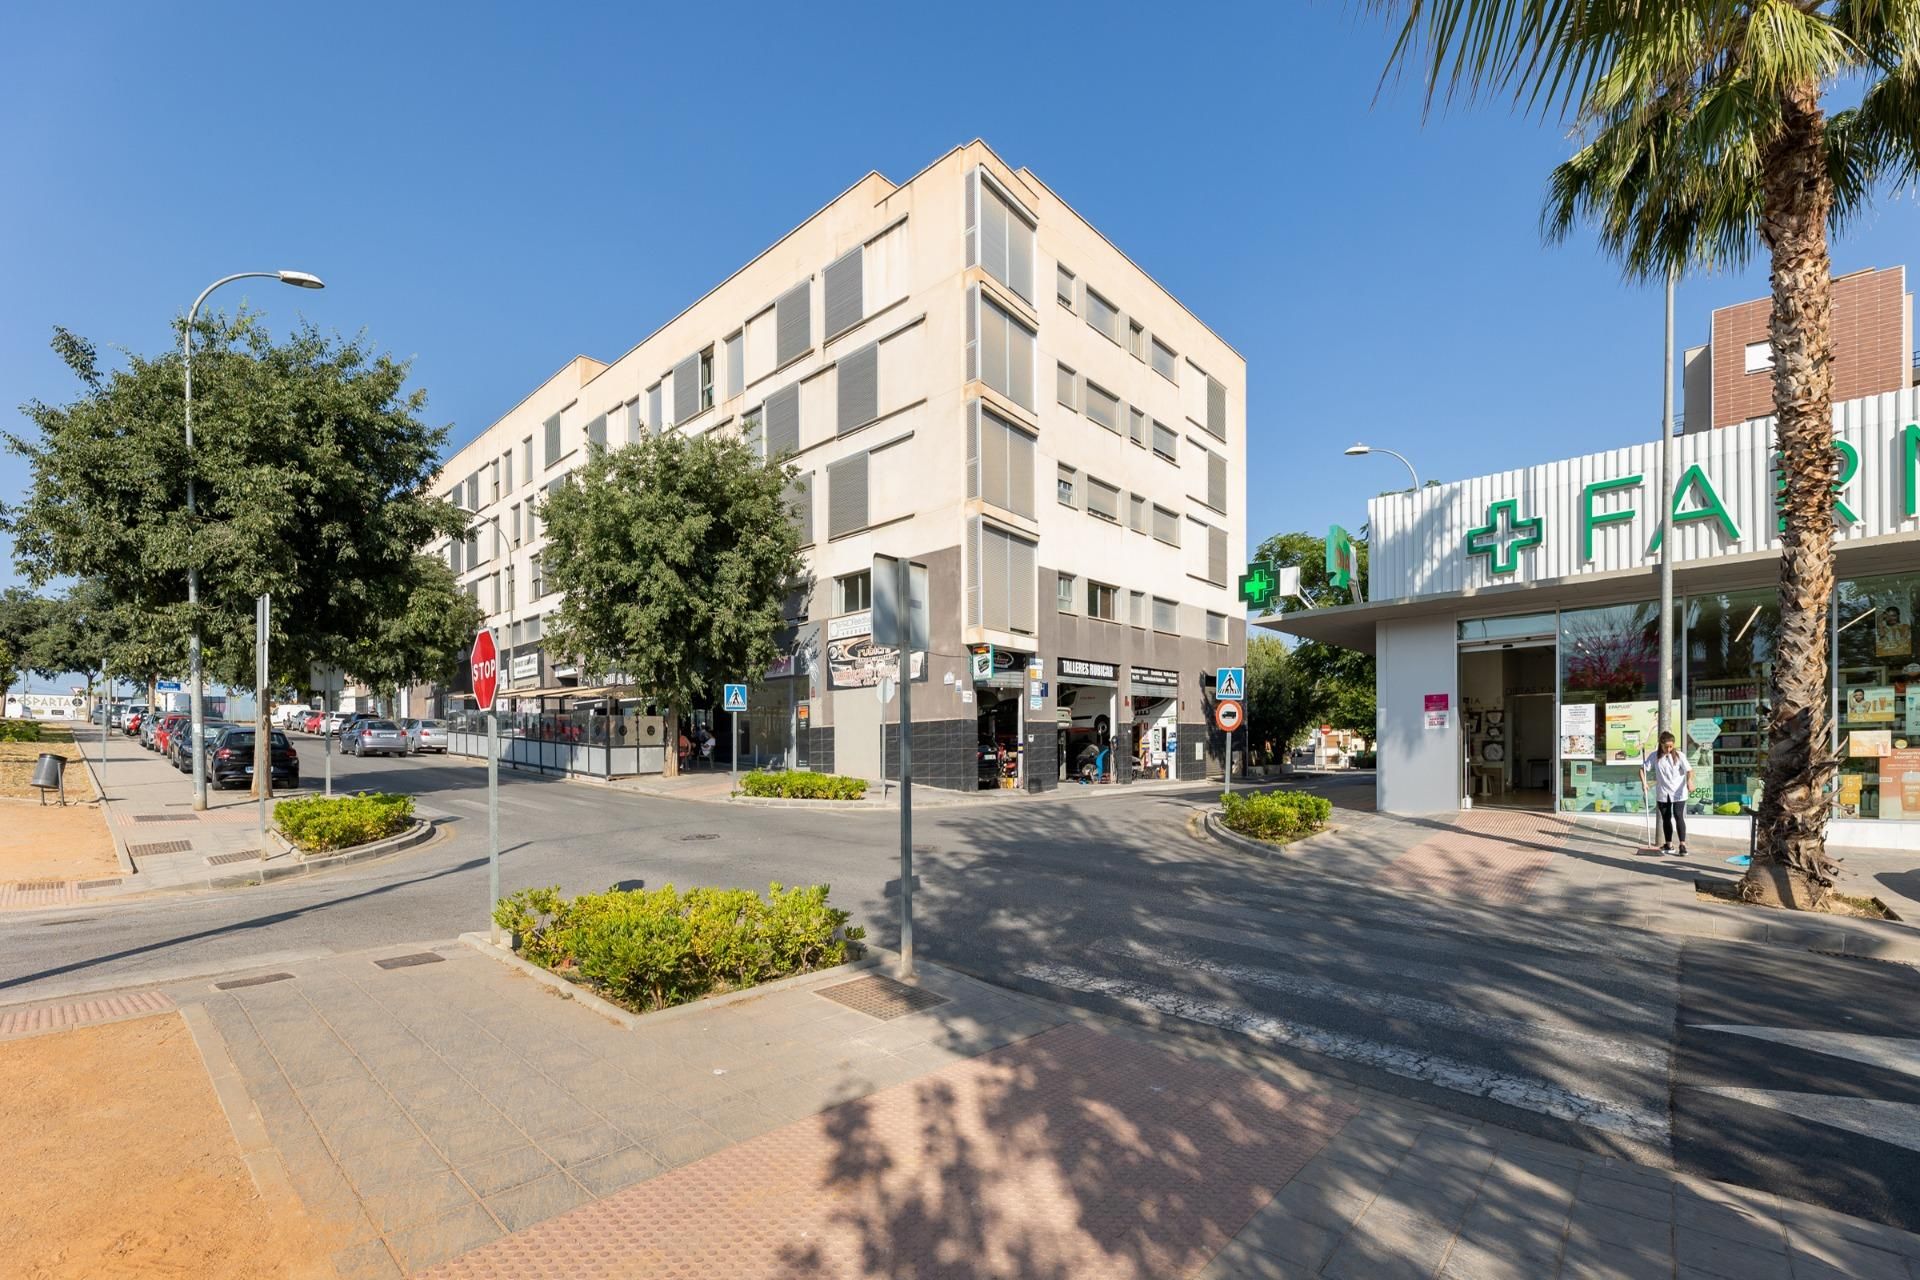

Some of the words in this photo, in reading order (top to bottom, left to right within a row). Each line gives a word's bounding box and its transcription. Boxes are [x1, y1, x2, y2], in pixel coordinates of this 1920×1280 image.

[473, 658, 496, 682] STOP
[1062, 660, 1090, 675] TALLERES
[1089, 663, 1114, 678] RUBICAR
[18, 695, 71, 707] ESPARTA
